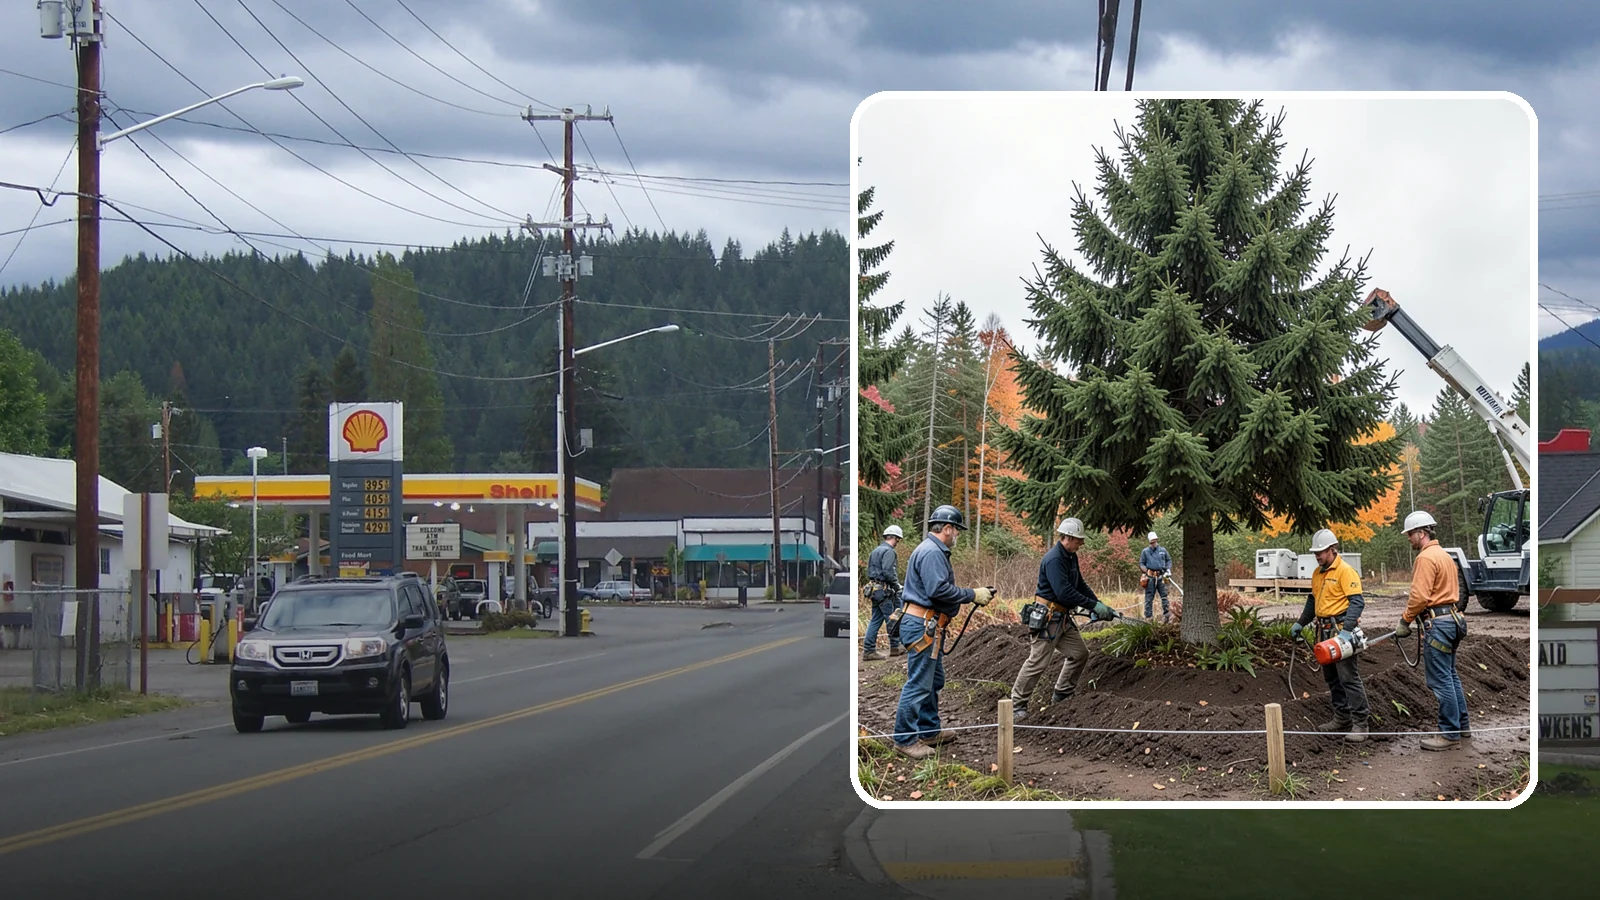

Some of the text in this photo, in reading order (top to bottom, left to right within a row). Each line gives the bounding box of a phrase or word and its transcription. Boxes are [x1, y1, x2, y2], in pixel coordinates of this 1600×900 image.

[366, 480, 383, 490] 395
[490, 484, 547, 499] Shell
[366, 494, 383, 504] 405
[366, 508, 383, 518] 415
[366, 522, 383, 532] 429
